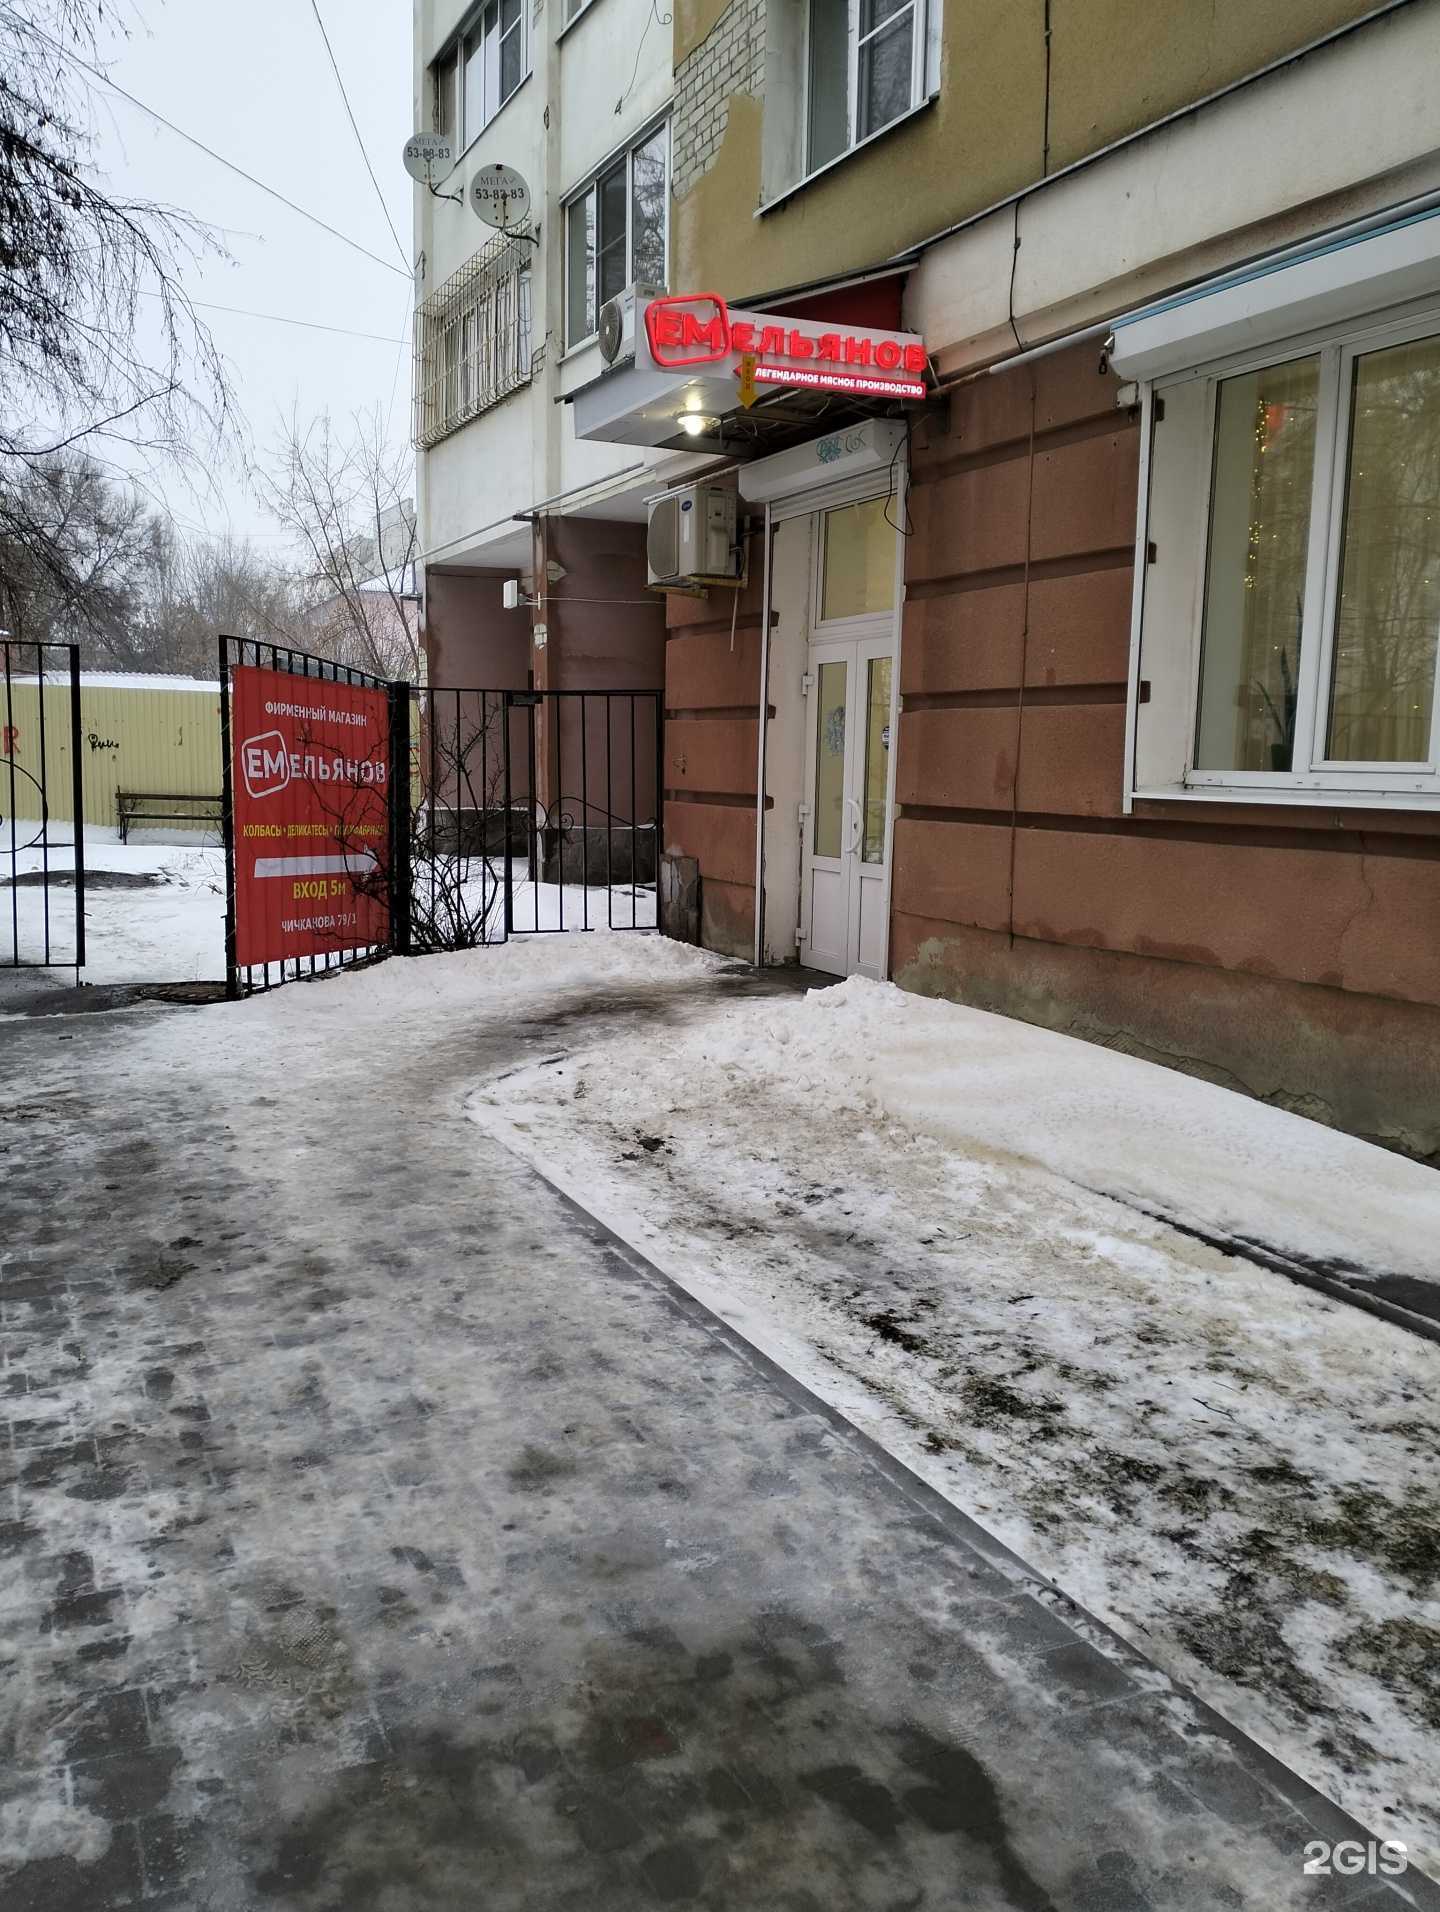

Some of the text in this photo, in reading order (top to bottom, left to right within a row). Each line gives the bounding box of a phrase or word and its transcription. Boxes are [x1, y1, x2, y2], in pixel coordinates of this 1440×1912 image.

[654, 310, 928, 373] ЕМЕЛЬЯНОВ
[755, 367, 818, 384] ЛЕГЕНДАРНОЕ
[820, 376, 855, 388] МЯСНОЕ
[856, 379, 923, 395] ПРОИЗВОДСТВО
[265, 701, 367, 727] ФИРМЕННЫЙ МАГАЗИН
[247, 748, 385, 784] ЕМЕЛЬЯНОВ
[243, 824, 282, 837] КОЛБАСЫ
[287, 824, 329, 837] ДЕЛИКАТЕСЫ
[293, 880, 328, 900] ВХОД
[281, 912, 356, 933] ЧИЧКАНОВА 79/1
